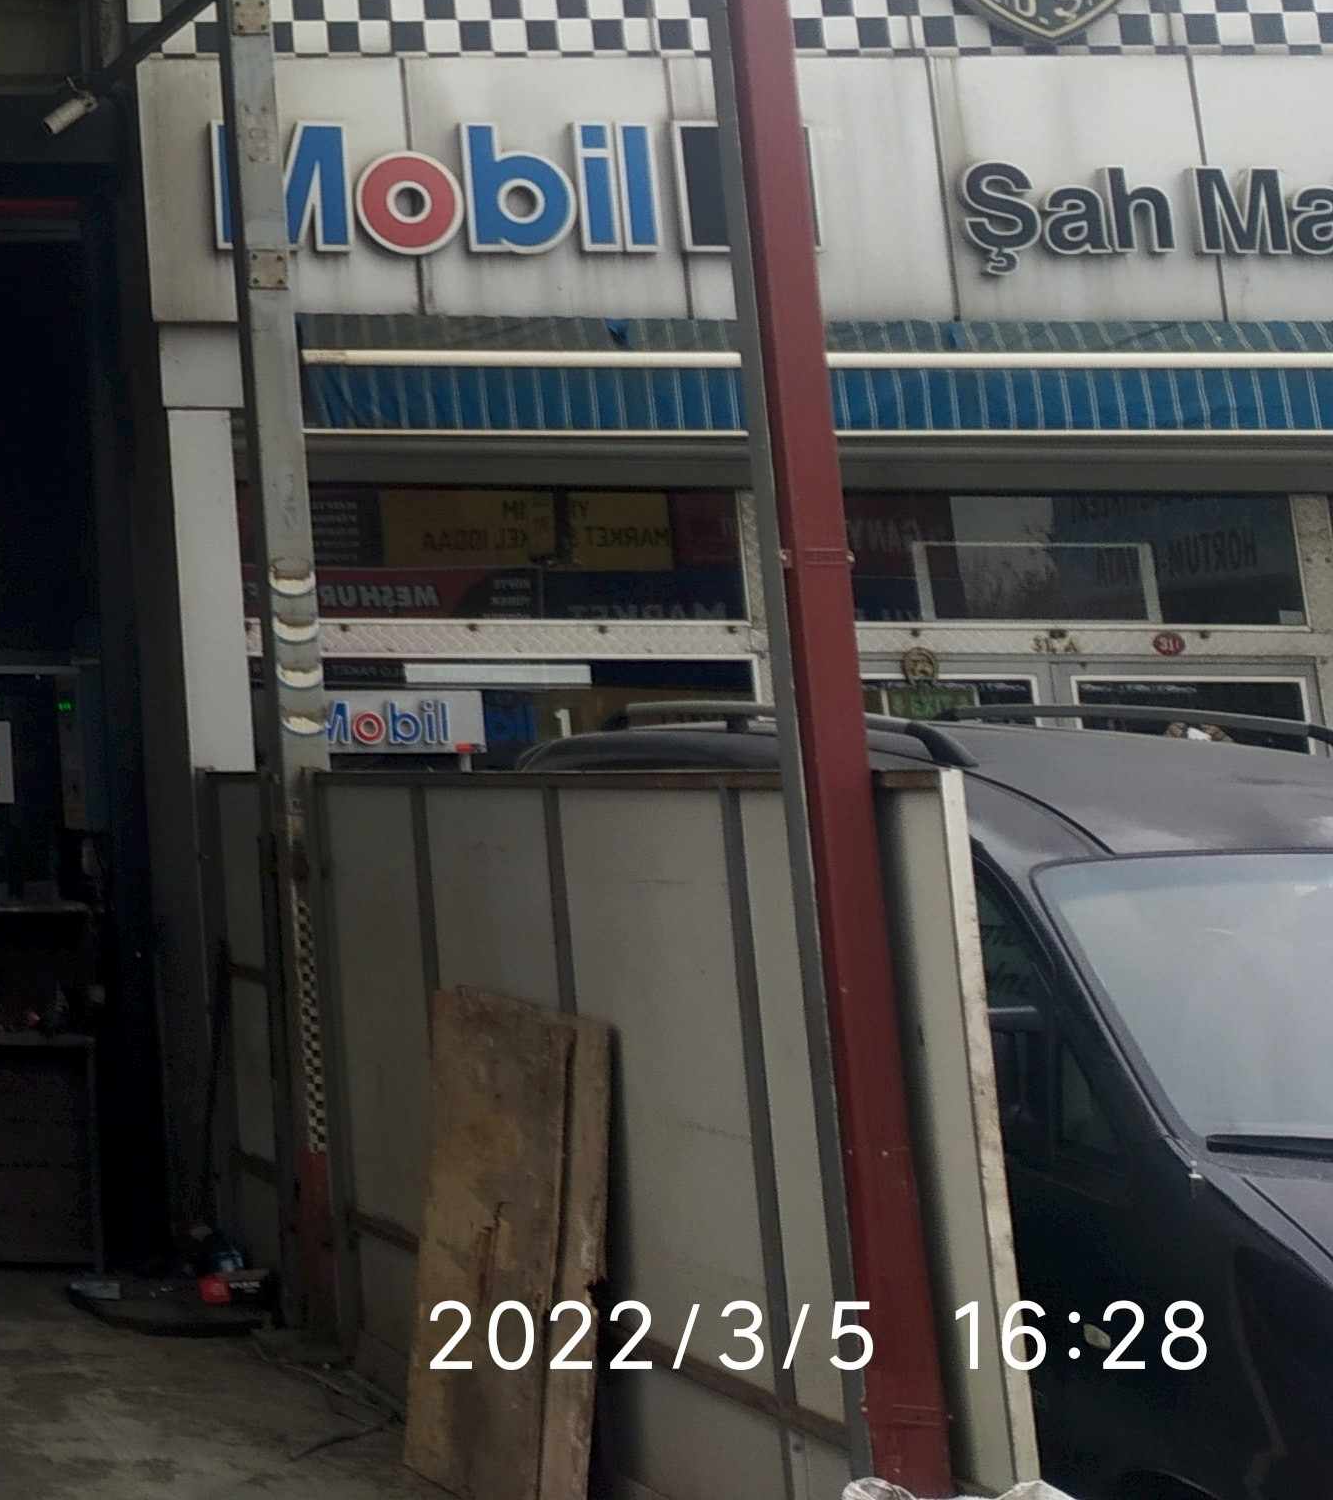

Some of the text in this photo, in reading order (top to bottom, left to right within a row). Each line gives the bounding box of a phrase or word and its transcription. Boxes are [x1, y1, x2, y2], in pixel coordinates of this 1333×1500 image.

[206, 119, 664, 255] Mobil
[959, 157, 1178, 277] Şah
[323, 698, 451, 747] Mobil
